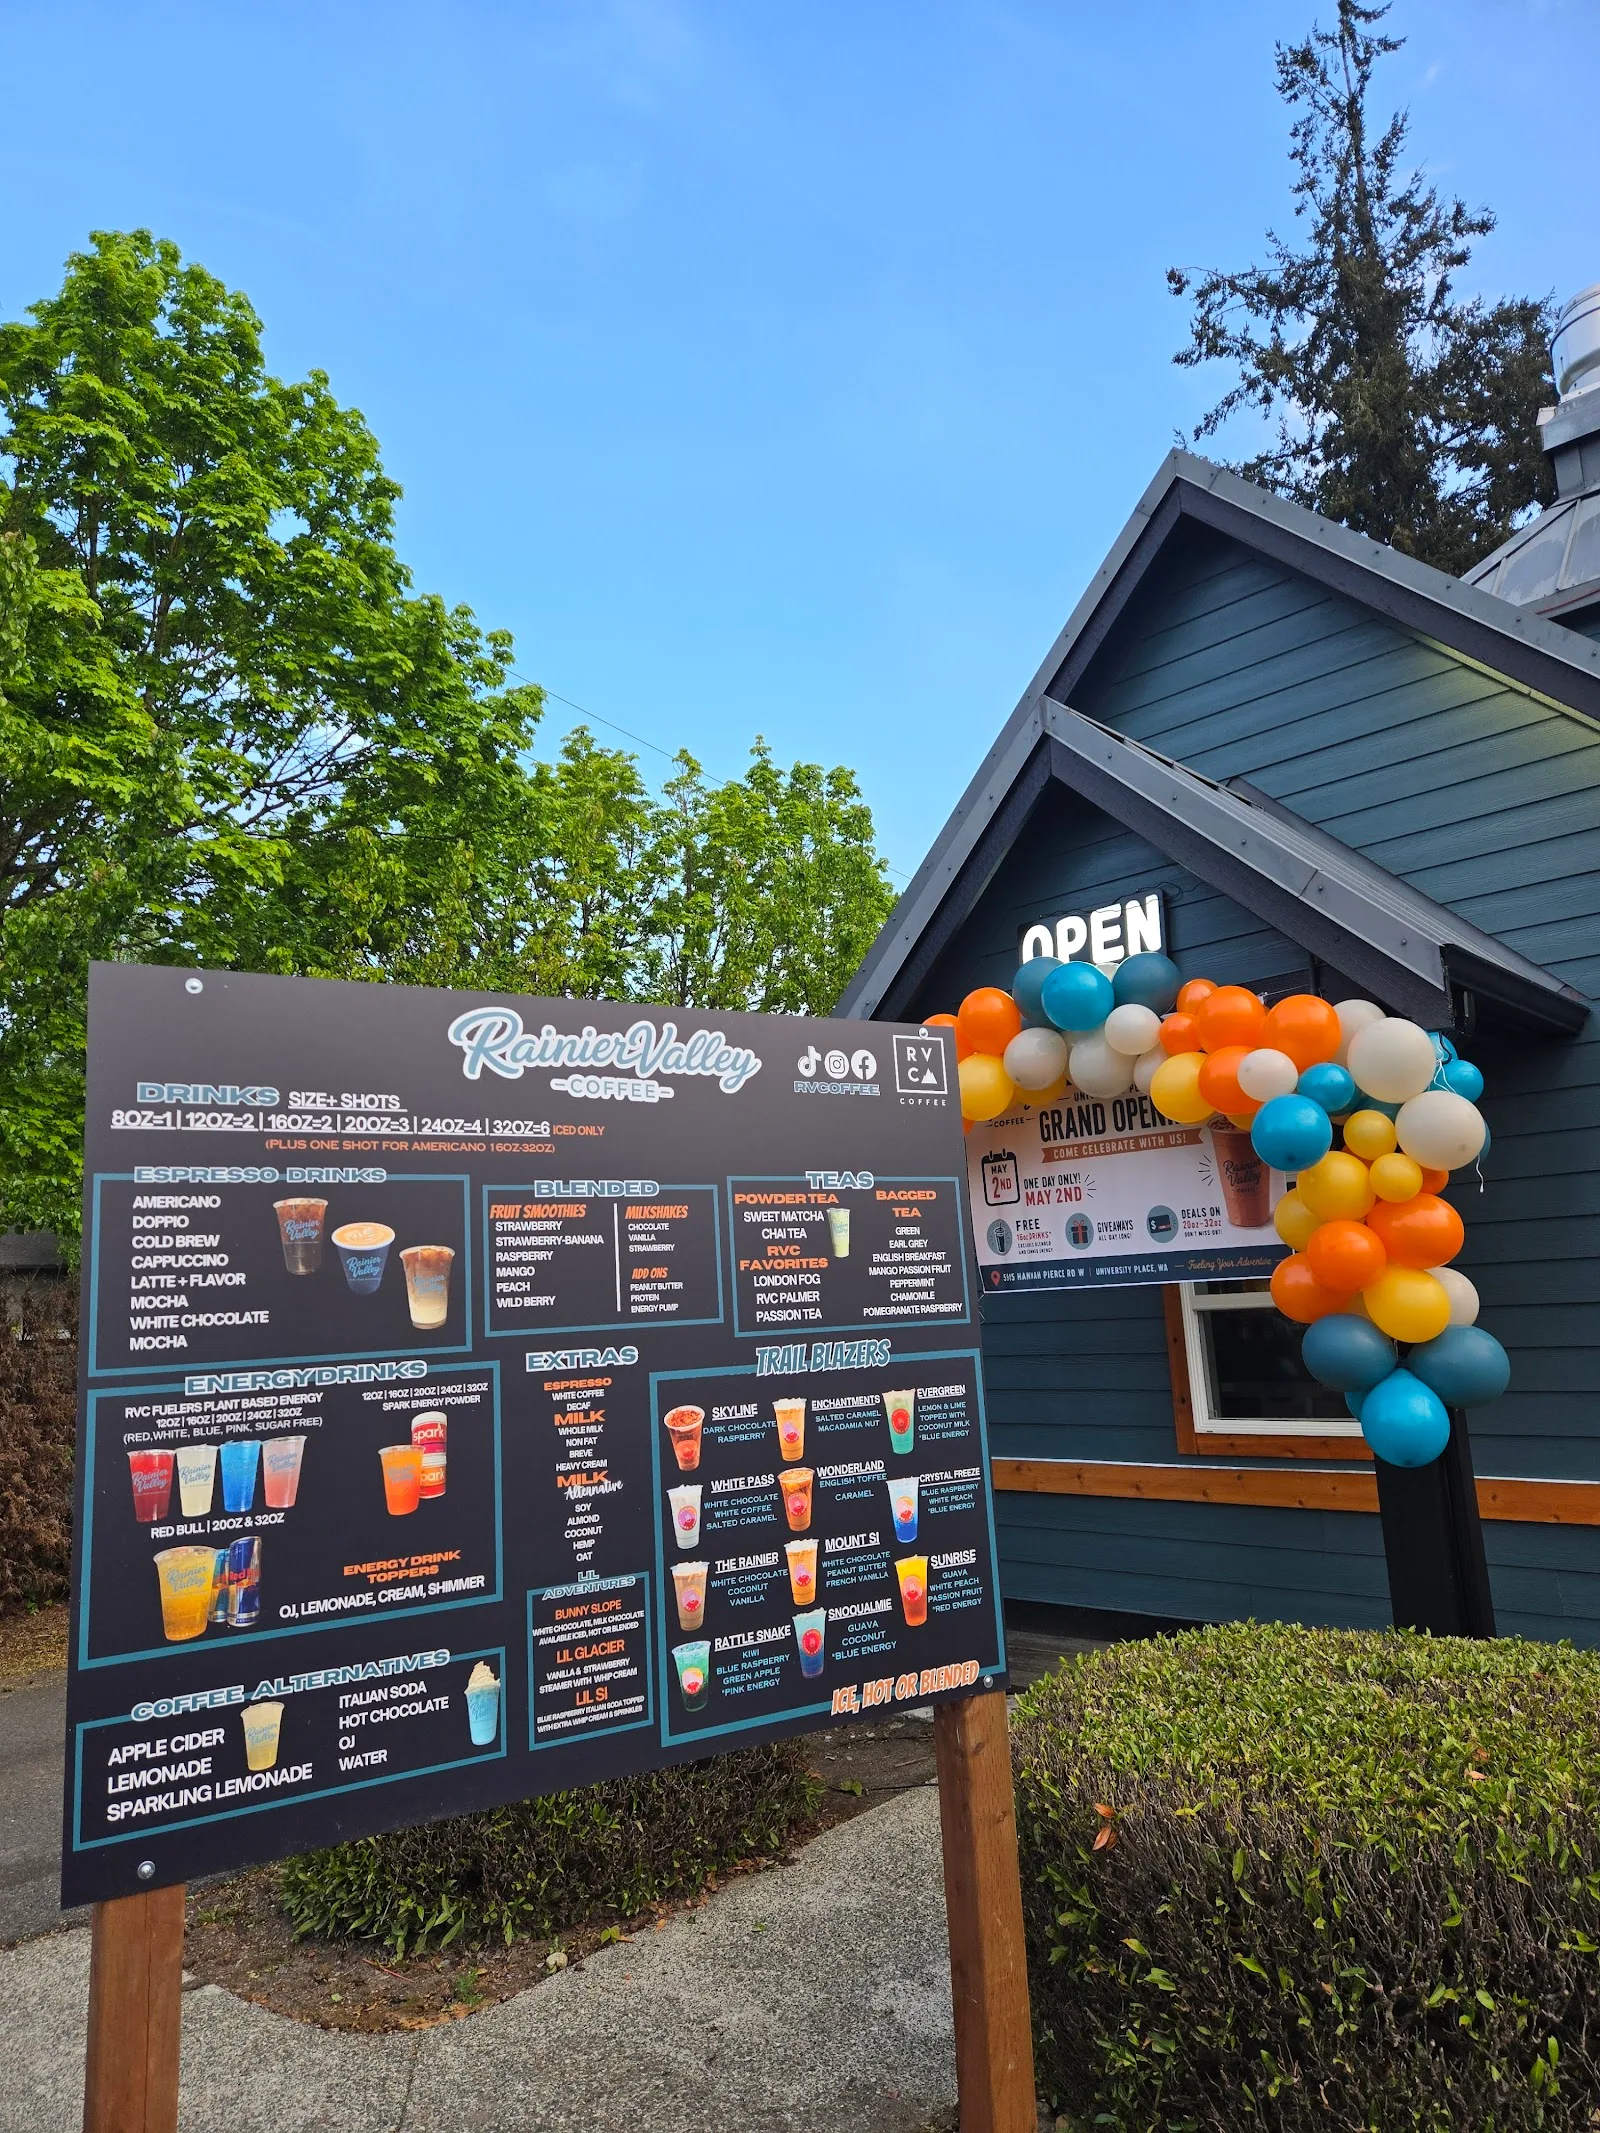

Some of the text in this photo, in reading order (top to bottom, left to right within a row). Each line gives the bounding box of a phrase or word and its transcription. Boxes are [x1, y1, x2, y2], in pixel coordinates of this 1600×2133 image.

[1023, 894, 1162, 964] OPEN
[137, 1082, 400, 1109] DRINKS SIZE+ SHOTS
[794, 1081, 880, 1096] RVCOFFEE
[900, 1098, 946, 1106] COFFEE
[994, 1117, 1025, 1127] COFFEE
[1039, 1096, 1180, 1142] GRAND OPEN
[553, 1125, 576, 1135] ICED
[578, 1125, 605, 1135] ONLY
[266, 1139, 307, 1150] (PLUS
[310, 1140, 339, 1150] ONE
[343, 1141, 379, 1150] SHOT
[382, 1141, 408, 1151] FOR
[412, 1142, 486, 1151] AMERICANO
[1054, 1133, 1186, 1159] COME CELEBRATE WITH US!
[134, 1166, 386, 1183] ESPRESSO DRINKS
[991, 1164, 1007, 1174] MAY
[806, 1171, 874, 1189] TEAS
[992, 1176, 1011, 1198] 2ND
[1024, 1173, 1080, 1189] ONE DAY ONLY!
[534, 1180, 659, 1197] BLENDED
[876, 1191, 936, 1200] BAGGED
[1026, 1186, 1082, 1206] MAY 2ND
[133, 1196, 221, 1209] AMERICANO
[735, 1194, 839, 1204] POWDER TEA
[490, 1204, 586, 1218] FRUIT SMOOTHIES
[625, 1206, 688, 1219] MILKSHAKES
[744, 1211, 824, 1222] SWEET MATCHA
[892, 1208, 921, 1217] TEA
[1182, 1207, 1220, 1219] DEALS ON
[495, 1221, 562, 1231] STRAWBERRY
[1016, 1219, 1040, 1231] FREE
[1098, 1220, 1133, 1232] GIVEAWAYS
[132, 1235, 220, 1249] COLD BREW
[496, 1235, 604, 1246] STRAWBERRY-BANANA
[496, 1251, 553, 1261] RASPBERRY
[767, 1246, 800, 1256] RVC
[132, 1254, 229, 1269] CAPPUCCINO
[740, 1259, 828, 1270] FAVORITES
[1188, 1256, 1271, 1271] Fueling Your Adventure
[632, 1267, 668, 1279] ADD ONS
[1044, 1269, 1065, 1278] PIERCE
[1067, 1269, 1075, 1277] RD
[1078, 1268, 1084, 1276] W
[1096, 1266, 1131, 1275] UNIVERSITY
[1134, 1264, 1156, 1274] PLACE,
[131, 1276, 176, 1289] LATTE
[190, 1273, 246, 1287] FLAVOR
[131, 1295, 188, 1309] MOCHA
[130, 1311, 269, 1330] WHITE CHOCOLATE
[757, 1309, 822, 1322] PASSION TEA
[130, 1335, 188, 1350] MOCHA
[526, 1346, 638, 1372] EXTRAS
[756, 1338, 891, 1377] TRAIL BLAZERS
[185, 1360, 427, 1396] ENERGY DRINKS
[544, 1378, 612, 1391] ESPRESSO
[917, 1385, 966, 1397] EVERGREEN
[125, 1393, 323, 1419] RVC FUELERS PLANT BASED ENERGY
[383, 1395, 480, 1411] SPARK ENERGY POWDER
[812, 1395, 880, 1409] ENCHANTMENTS
[554, 1410, 605, 1426] MILK
[712, 1403, 758, 1418] SKYLINE
[414, 1423, 444, 1443] spark
[703, 1421, 777, 1435] DARK CHOCOLATE
[817, 1460, 884, 1477] WONDERLAND
[920, 1468, 980, 1482] CRYSTAL FREEZE
[557, 1471, 608, 1488] MILK
[711, 1474, 774, 1491] WHITE PASS
[564, 1480, 623, 1500] Alternative
[151, 1528, 174, 1539] RED
[177, 1523, 205, 1535] BULL
[244, 1517, 253, 1527] &
[825, 1532, 879, 1550] MOUNT SI
[344, 1550, 461, 1576] ENERGY DRINK
[715, 1552, 779, 1571] THE RAINIER
[931, 1550, 976, 1567] SUNRISE
[367, 1565, 439, 1584] TOPPERS
[578, 1570, 599, 1582] LIL
[542, 1576, 635, 1600] ADVENTURES
[279, 1575, 485, 1619] OJ, LEMONADE, CREAM, SHIMMER
[555, 1600, 622, 1620] BUNNY SLOPE
[828, 1598, 892, 1619] SNOQUALMIE
[714, 1625, 791, 1649] RATTLE SNAKE
[131, 1648, 450, 1721] COFFEE ALTERNATIVES
[831, 1660, 980, 1716] ICE, HOT OR BLENDED
[339, 1681, 427, 1709] ITALIAN SODA
[108, 1728, 225, 1766] APPLE CIDER
[339, 1735, 355, 1750] OJ
[339, 1750, 387, 1771] WATER
[108, 1757, 212, 1794] LEMONADE
[106, 1763, 312, 1822] SPARKLING LEMONADE
